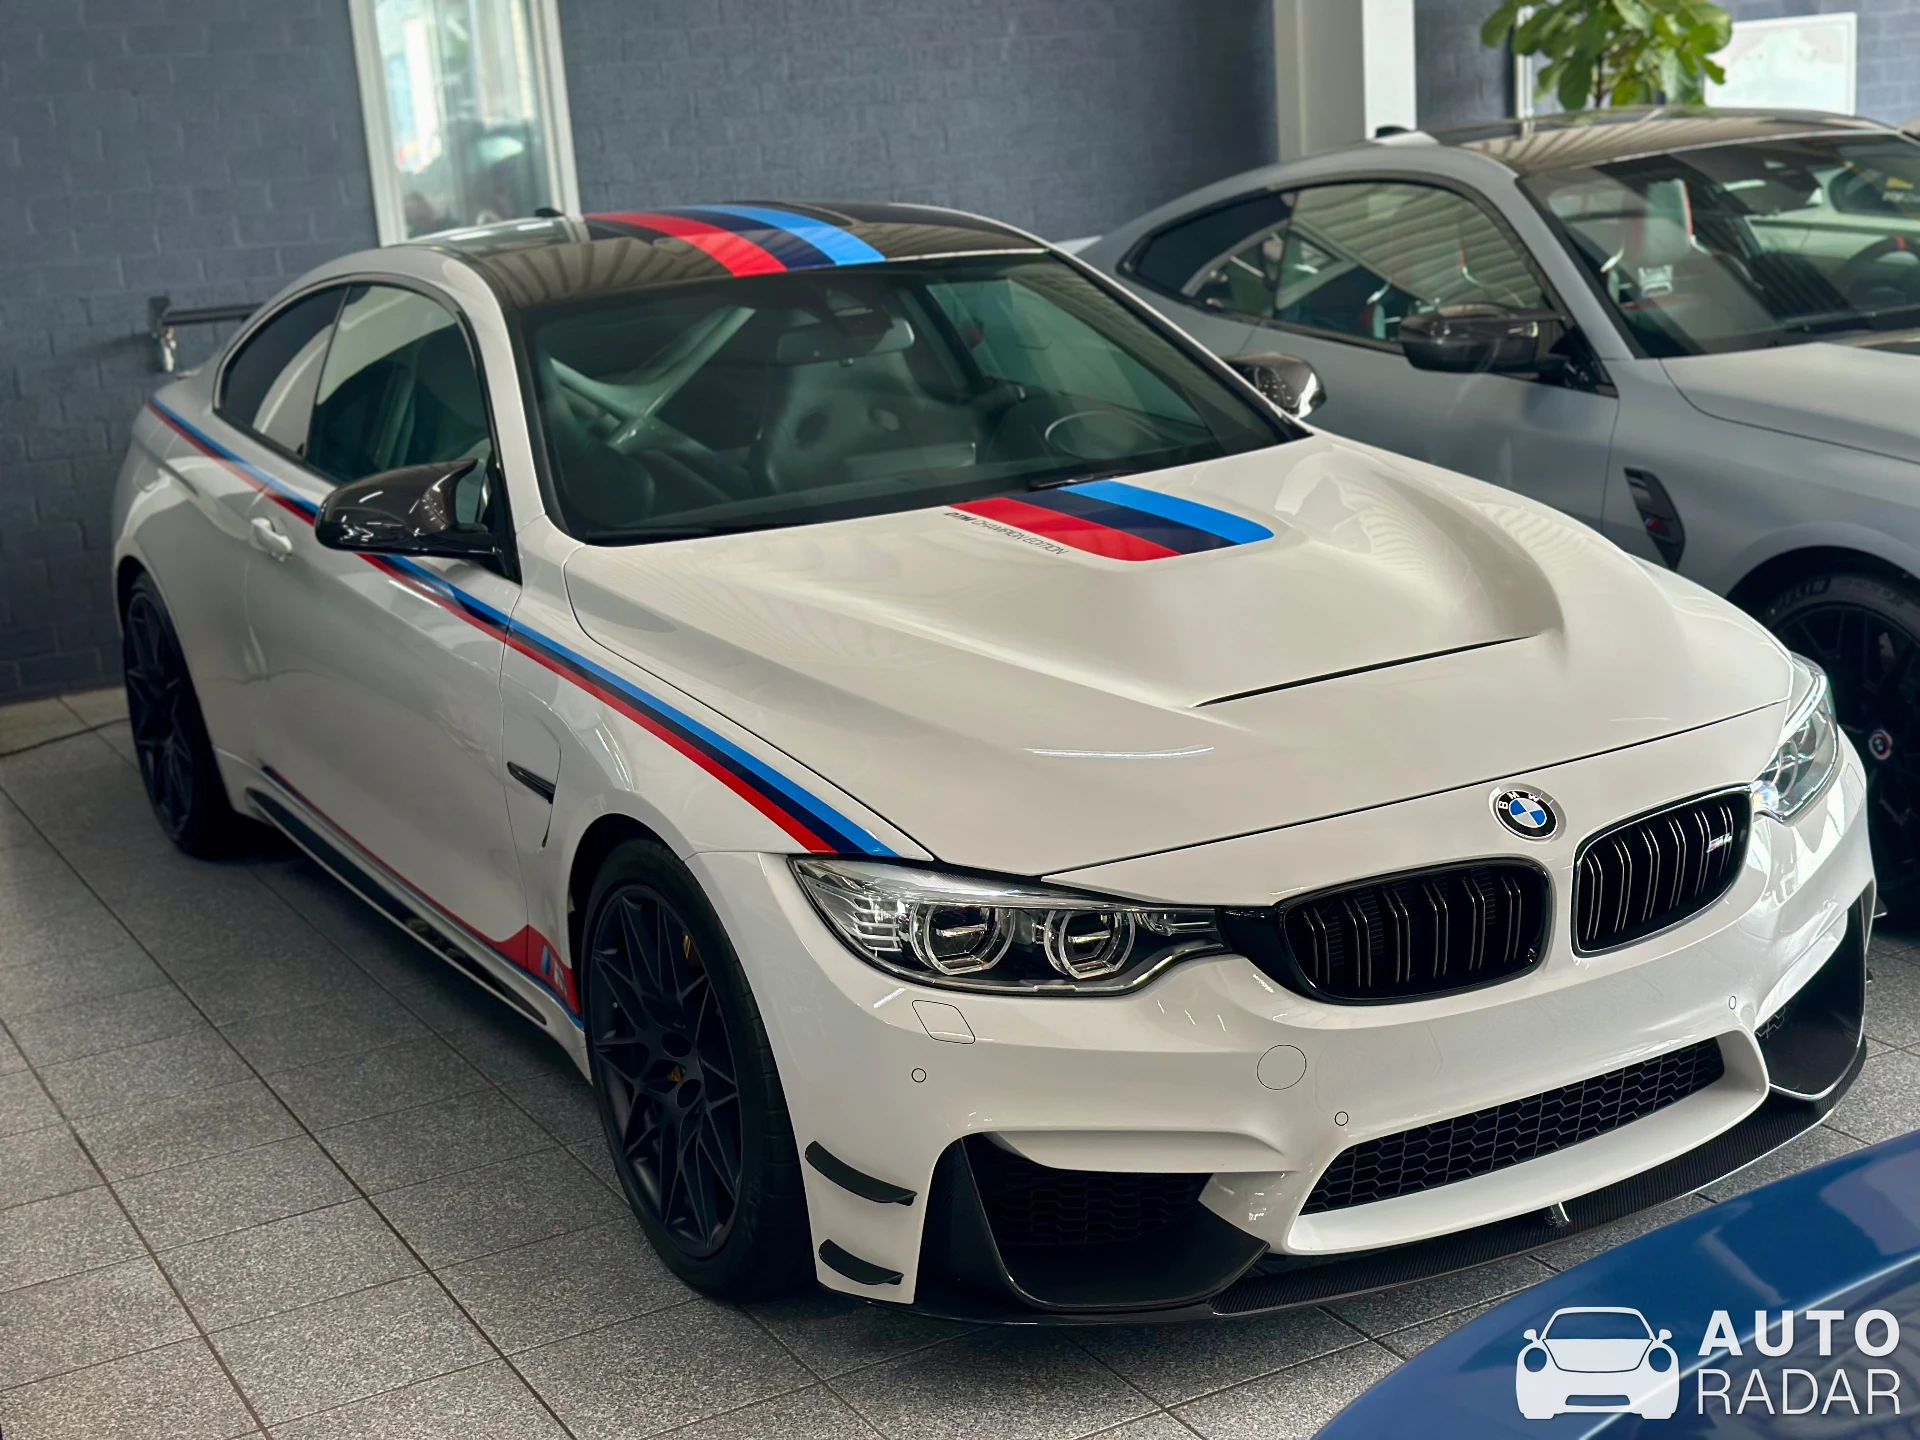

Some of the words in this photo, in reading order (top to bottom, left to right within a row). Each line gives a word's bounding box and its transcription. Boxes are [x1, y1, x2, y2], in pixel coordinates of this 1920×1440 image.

[972, 519, 1026, 541] CHAMPION
[1023, 537, 1069, 555] EDITION
[1498, 791, 1540, 810] BMW
